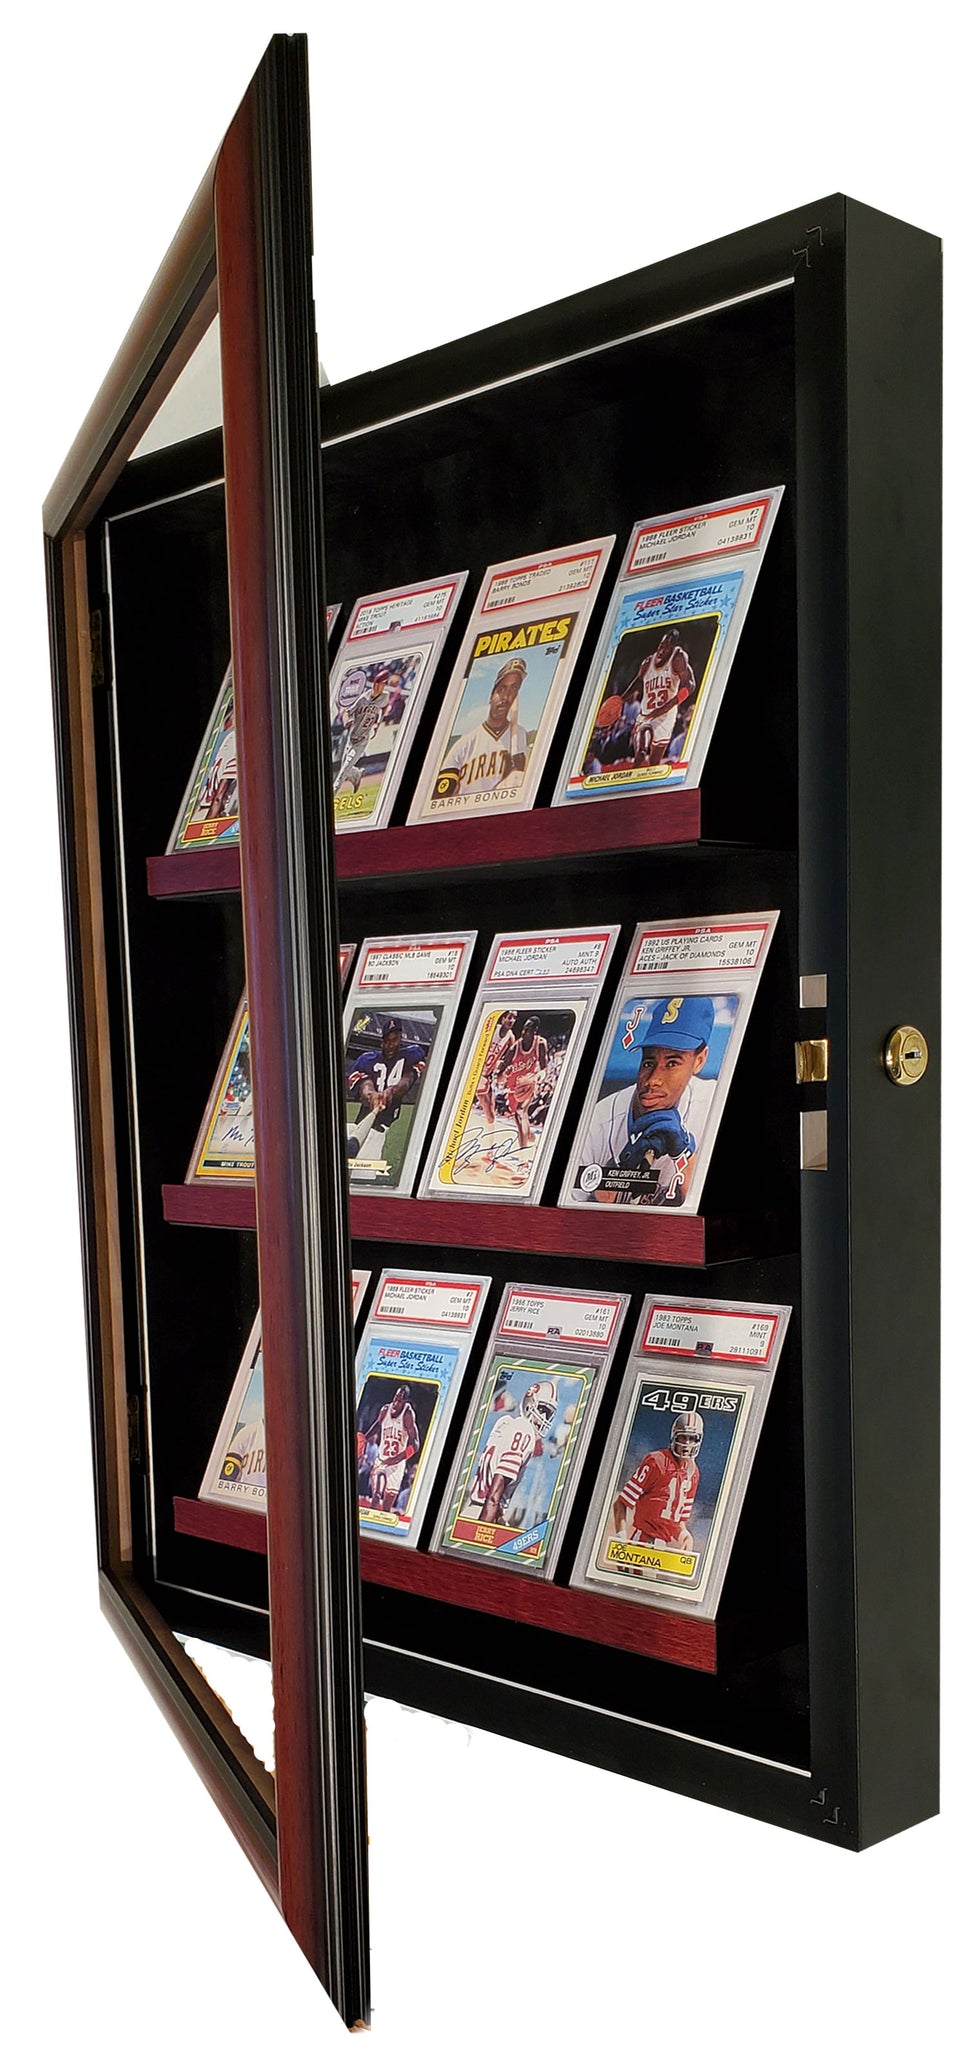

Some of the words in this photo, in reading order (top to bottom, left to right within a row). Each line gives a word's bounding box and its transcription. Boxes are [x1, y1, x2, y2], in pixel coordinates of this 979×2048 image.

[659, 527, 678, 538] FLEER
[679, 521, 707, 534] STICKER
[639, 537, 667, 549] MICHAEL
[668, 531, 696, 543] JORDAN
[634, 596, 664, 611] FLEER
[664, 584, 724, 605] BASKETBALL
[661, 602, 684, 616] Star
[685, 596, 718, 611] Sticker
[473, 617, 571, 658] PIRATES
[646, 690, 669, 710] 23
[430, 794, 470, 810] BARRY
[475, 788, 518, 803] BONDS
[661, 938, 670, 946] US
[671, 936, 698, 945] PLAYING
[700, 935, 723, 943] CARDS
[728, 941, 745, 949] GEM
[515, 947, 532, 955] FLEER
[533, 945, 557, 953] STICKER
[642, 946, 654, 954] KEN
[655, 945, 680, 953] GRIFFEY
[499, 955, 522, 963] MICHAEL
[523, 953, 547, 961] JORDAN
[580, 958, 597, 966] AUTH
[639, 954, 656, 962] ACES
[660, 953, 679, 961] JACK
[679, 952, 688, 960] OF
[689, 950, 726, 959] DIAMONDS
[660, 997, 685, 1025] S
[626, 1006, 645, 1031] J
[374, 1057, 406, 1092] 34
[454, 1098, 470, 1130] Jordan
[607, 1169, 620, 1177] KEN
[604, 1181, 630, 1189] OUTFIELD
[384, 1292, 405, 1300] MICHAEL
[399, 1286, 414, 1294] FLEER
[526, 1300, 544, 1308] TOPPS
[584, 1313, 599, 1321] GEM
[672, 1316, 692, 1324] TOPPS
[665, 1323, 699, 1333] MONTANA
[751, 1323, 769, 1331] #169
[749, 1331, 767, 1339] MINT
[378, 1347, 400, 1358] FLEER
[400, 1350, 444, 1363] BASKETBALL
[377, 1356, 397, 1368] Super
[398, 1359, 414, 1369] Star
[415, 1361, 439, 1373] Sticker
[642, 1389, 738, 1414] 49ERS
[383, 1439, 400, 1457] 23
[511, 1432, 532, 1453] 80
[633, 1464, 649, 1483] 16
[218, 1481, 250, 1494] BARRY
[474, 1532, 495, 1543] RICE
[512, 1530, 539, 1551] 49ERS
[611, 1542, 628, 1551] JOE
[609, 1550, 662, 1568] MONTANA
[680, 1556, 693, 1565] QB
